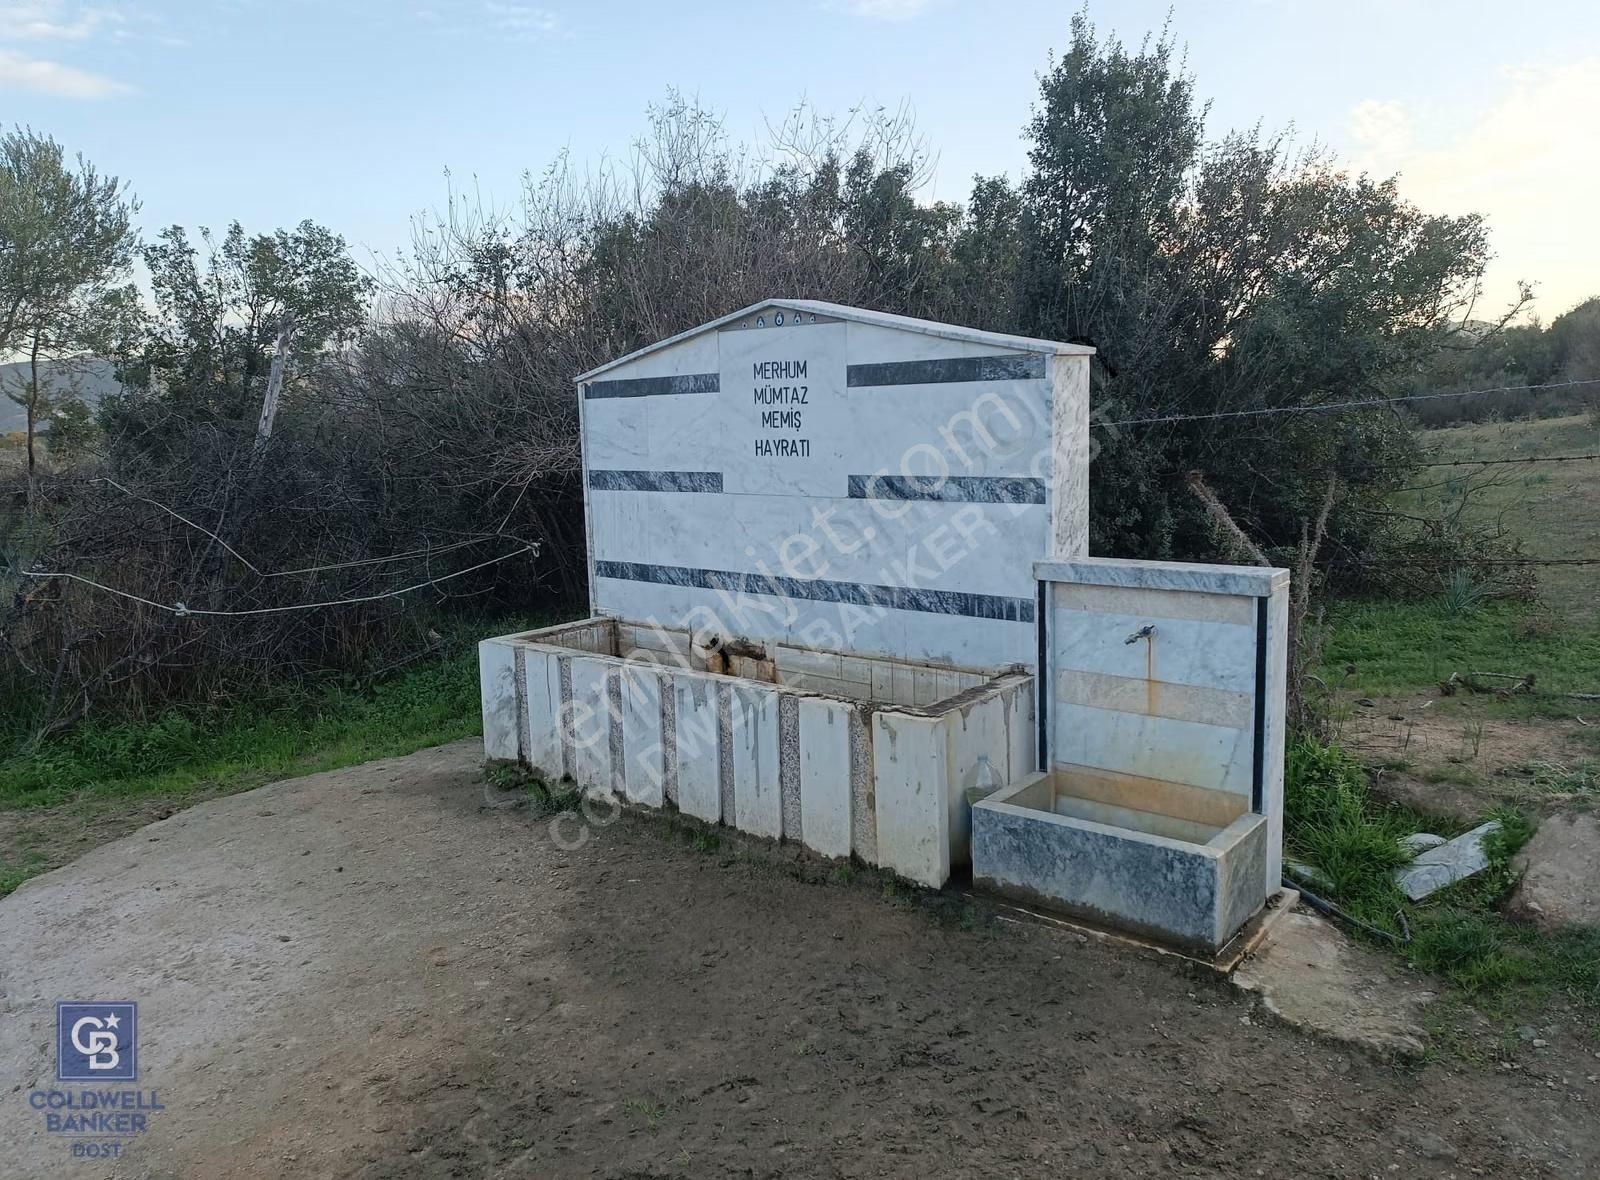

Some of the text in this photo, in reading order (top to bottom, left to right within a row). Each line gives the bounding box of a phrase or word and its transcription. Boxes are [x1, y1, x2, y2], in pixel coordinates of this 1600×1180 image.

[753, 360, 808, 380] MERHUM
[753, 384, 809, 405] MÜMTAZ
[761, 407, 802, 432] MEMİŞ
[754, 439, 810, 457] HAYRATI
